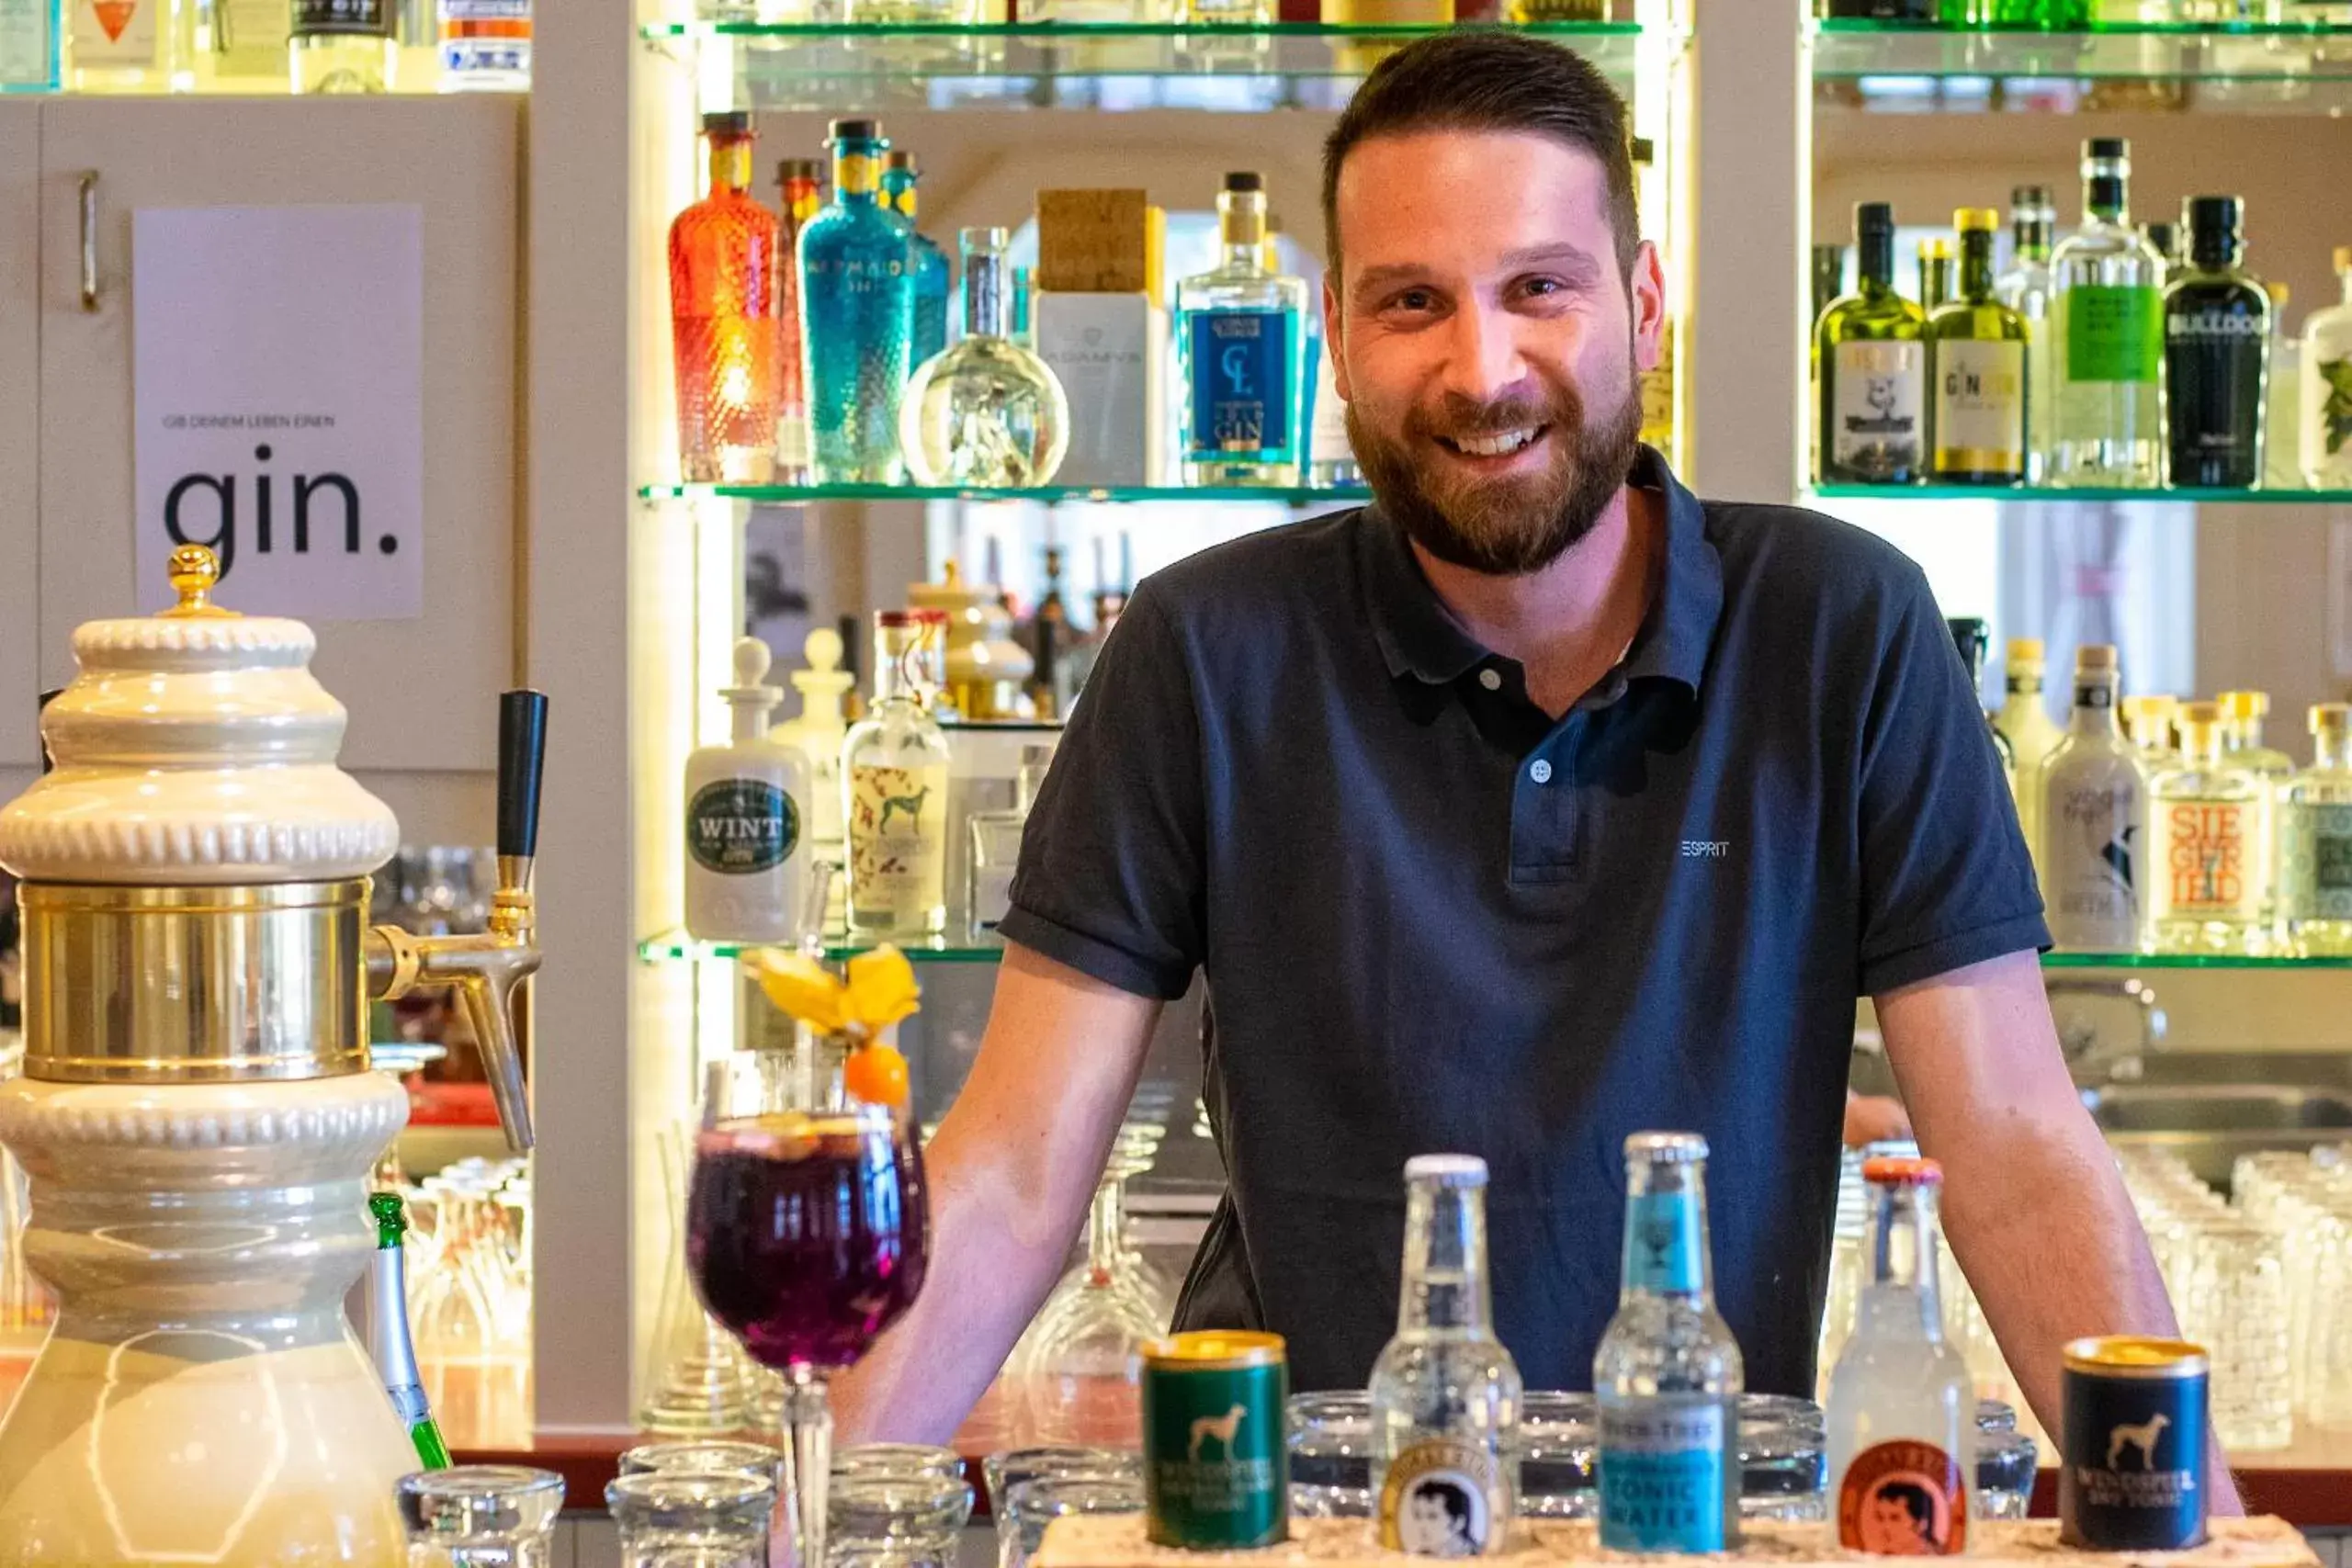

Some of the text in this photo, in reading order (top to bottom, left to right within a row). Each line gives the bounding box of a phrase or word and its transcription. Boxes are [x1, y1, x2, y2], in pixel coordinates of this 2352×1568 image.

[162, 414, 336, 428] GIB DEINEM LEBEN EINEN
[164, 443, 399, 585] gin.
[699, 817, 783, 838] WINT
[1681, 840, 1730, 857] ESPRIT
[1608, 1477, 1697, 1502] TONIC
[1608, 1505, 1698, 1529] WATER
